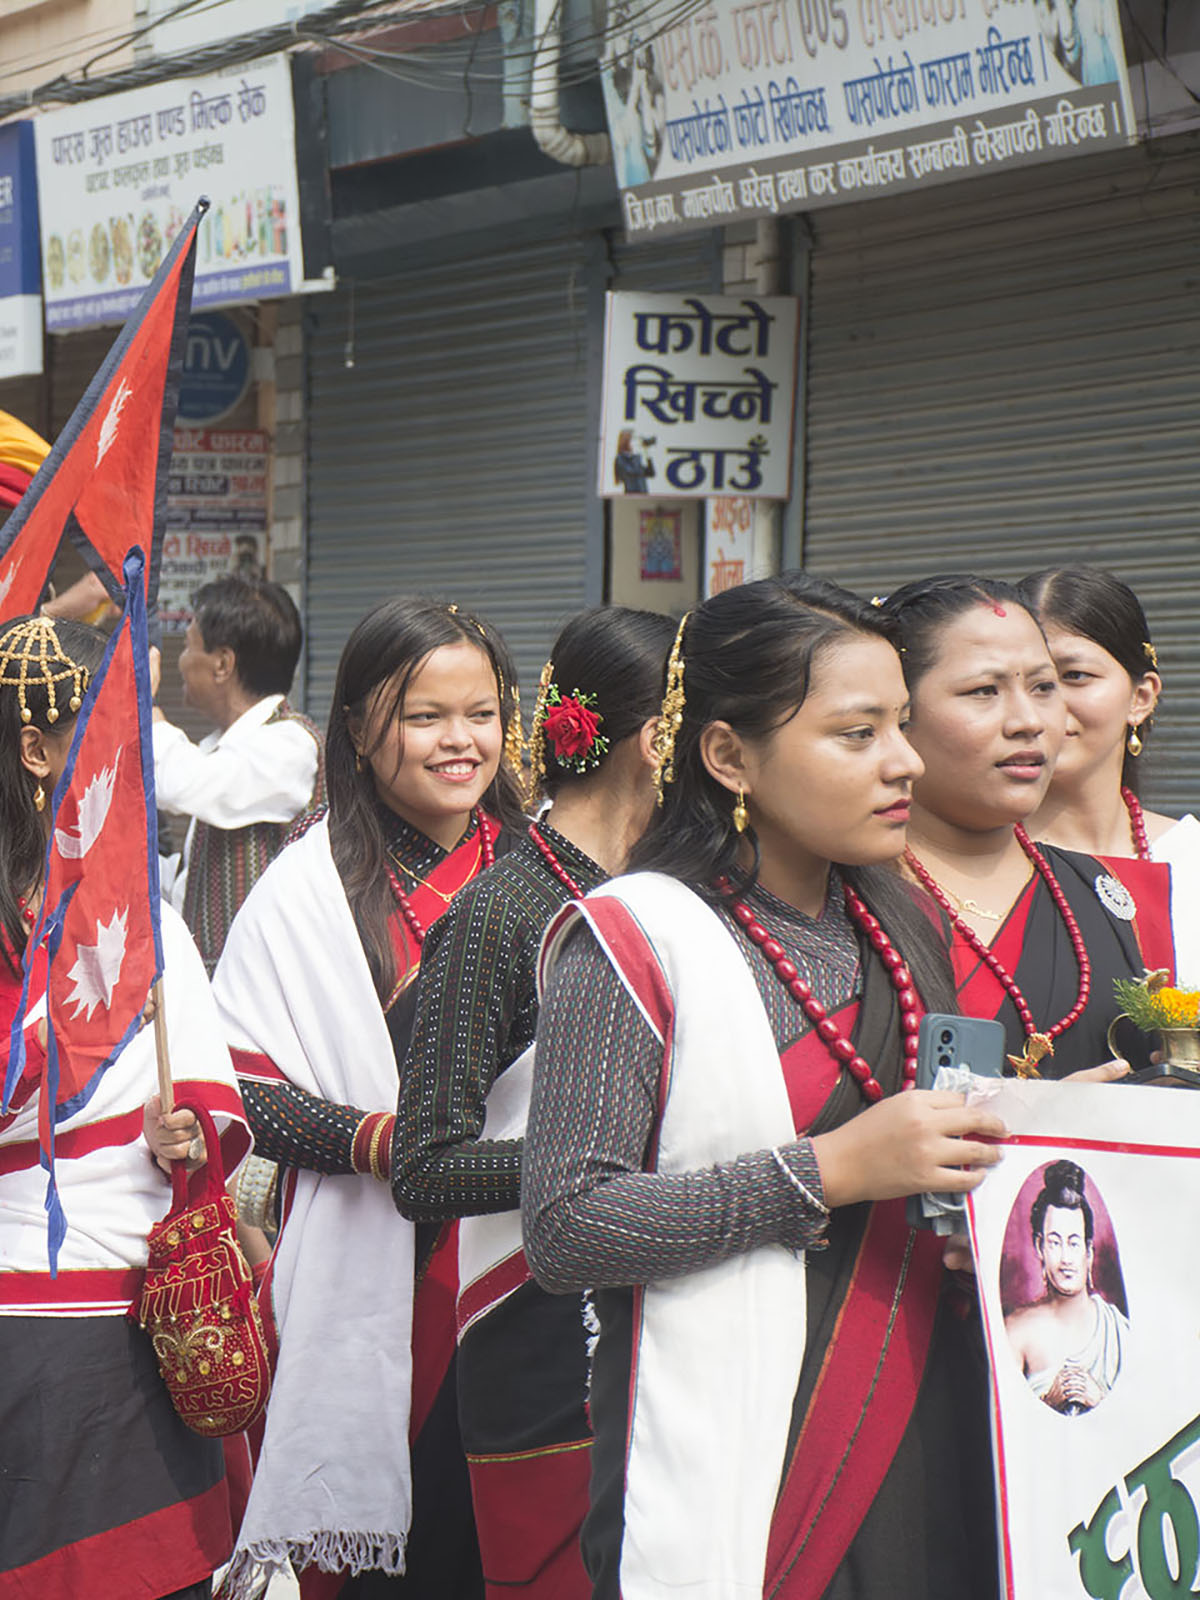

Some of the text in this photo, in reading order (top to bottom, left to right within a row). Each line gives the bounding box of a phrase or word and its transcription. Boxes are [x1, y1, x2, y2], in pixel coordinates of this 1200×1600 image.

[116, 113, 153, 154] हाउस
[156, 105, 187, 141] एण्ड
[665, 93, 733, 164] पासपोर्टको
[732, 85, 770, 147] फोटो
[842, 50, 920, 127] पासपोर्टको
[919, 52, 975, 107] फाराम
[776, 167, 809, 203] तथा
[807, 162, 837, 196] कर
[836, 146, 906, 189] कार्यालय
[970, 108, 1043, 164] लेखापढी
[633, 299, 776, 358] फोटो
[623, 363, 779, 424] खिच्ने
[665, 433, 772, 491] ठाउँ
